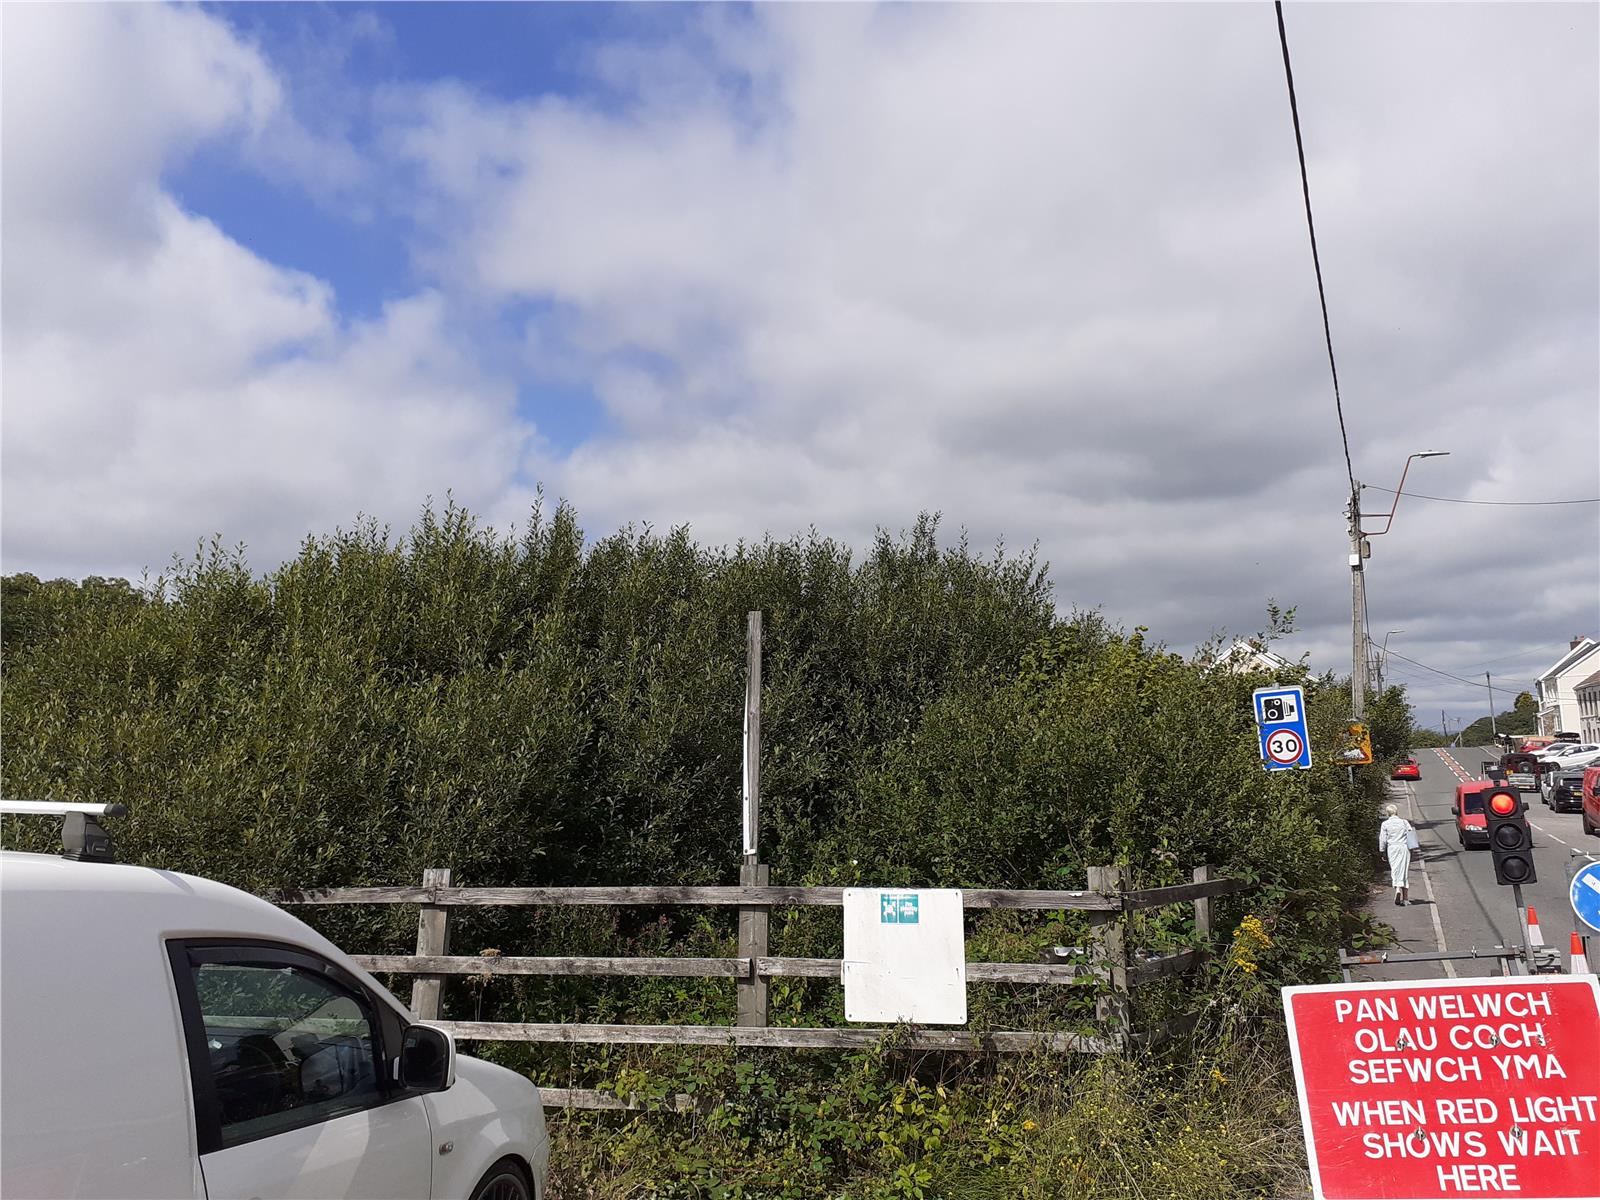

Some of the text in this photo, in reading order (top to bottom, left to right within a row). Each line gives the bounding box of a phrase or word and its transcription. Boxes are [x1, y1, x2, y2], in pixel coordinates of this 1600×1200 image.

[1272, 739, 1297, 754] 30
[1335, 992, 1552, 1023] PAN WELWCH
[1355, 1023, 1546, 1053] OLAU COCH
[1349, 1054, 1567, 1084] SEFWCH YMA
[1332, 1096, 1598, 1126] WHEN RED LIGHT
[1363, 1129, 1581, 1158] SHOWS WAIT
[1437, 1164, 1521, 1191] HERE
